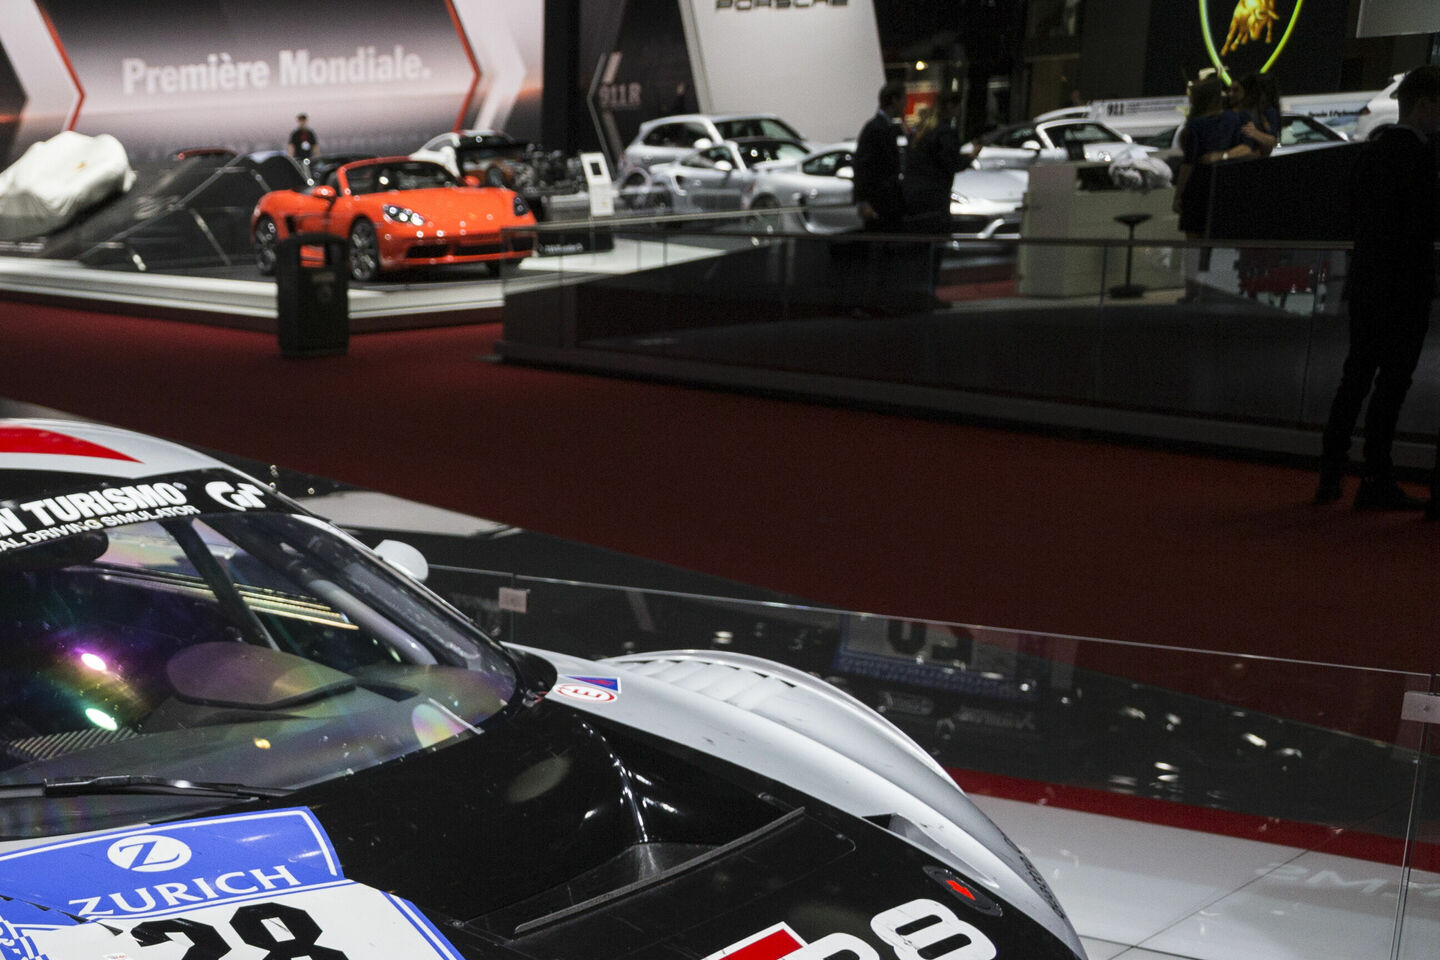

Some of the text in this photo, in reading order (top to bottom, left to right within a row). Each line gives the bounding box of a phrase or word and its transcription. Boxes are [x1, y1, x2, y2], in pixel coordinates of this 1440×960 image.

[122, 45, 431, 95] Première Mondiale.
[20, 482, 187, 527] TURISMO
[23, 518, 102, 544] DRIVING
[100, 504, 201, 528] SIMULATOR
[68, 865, 302, 916] ZURICH
